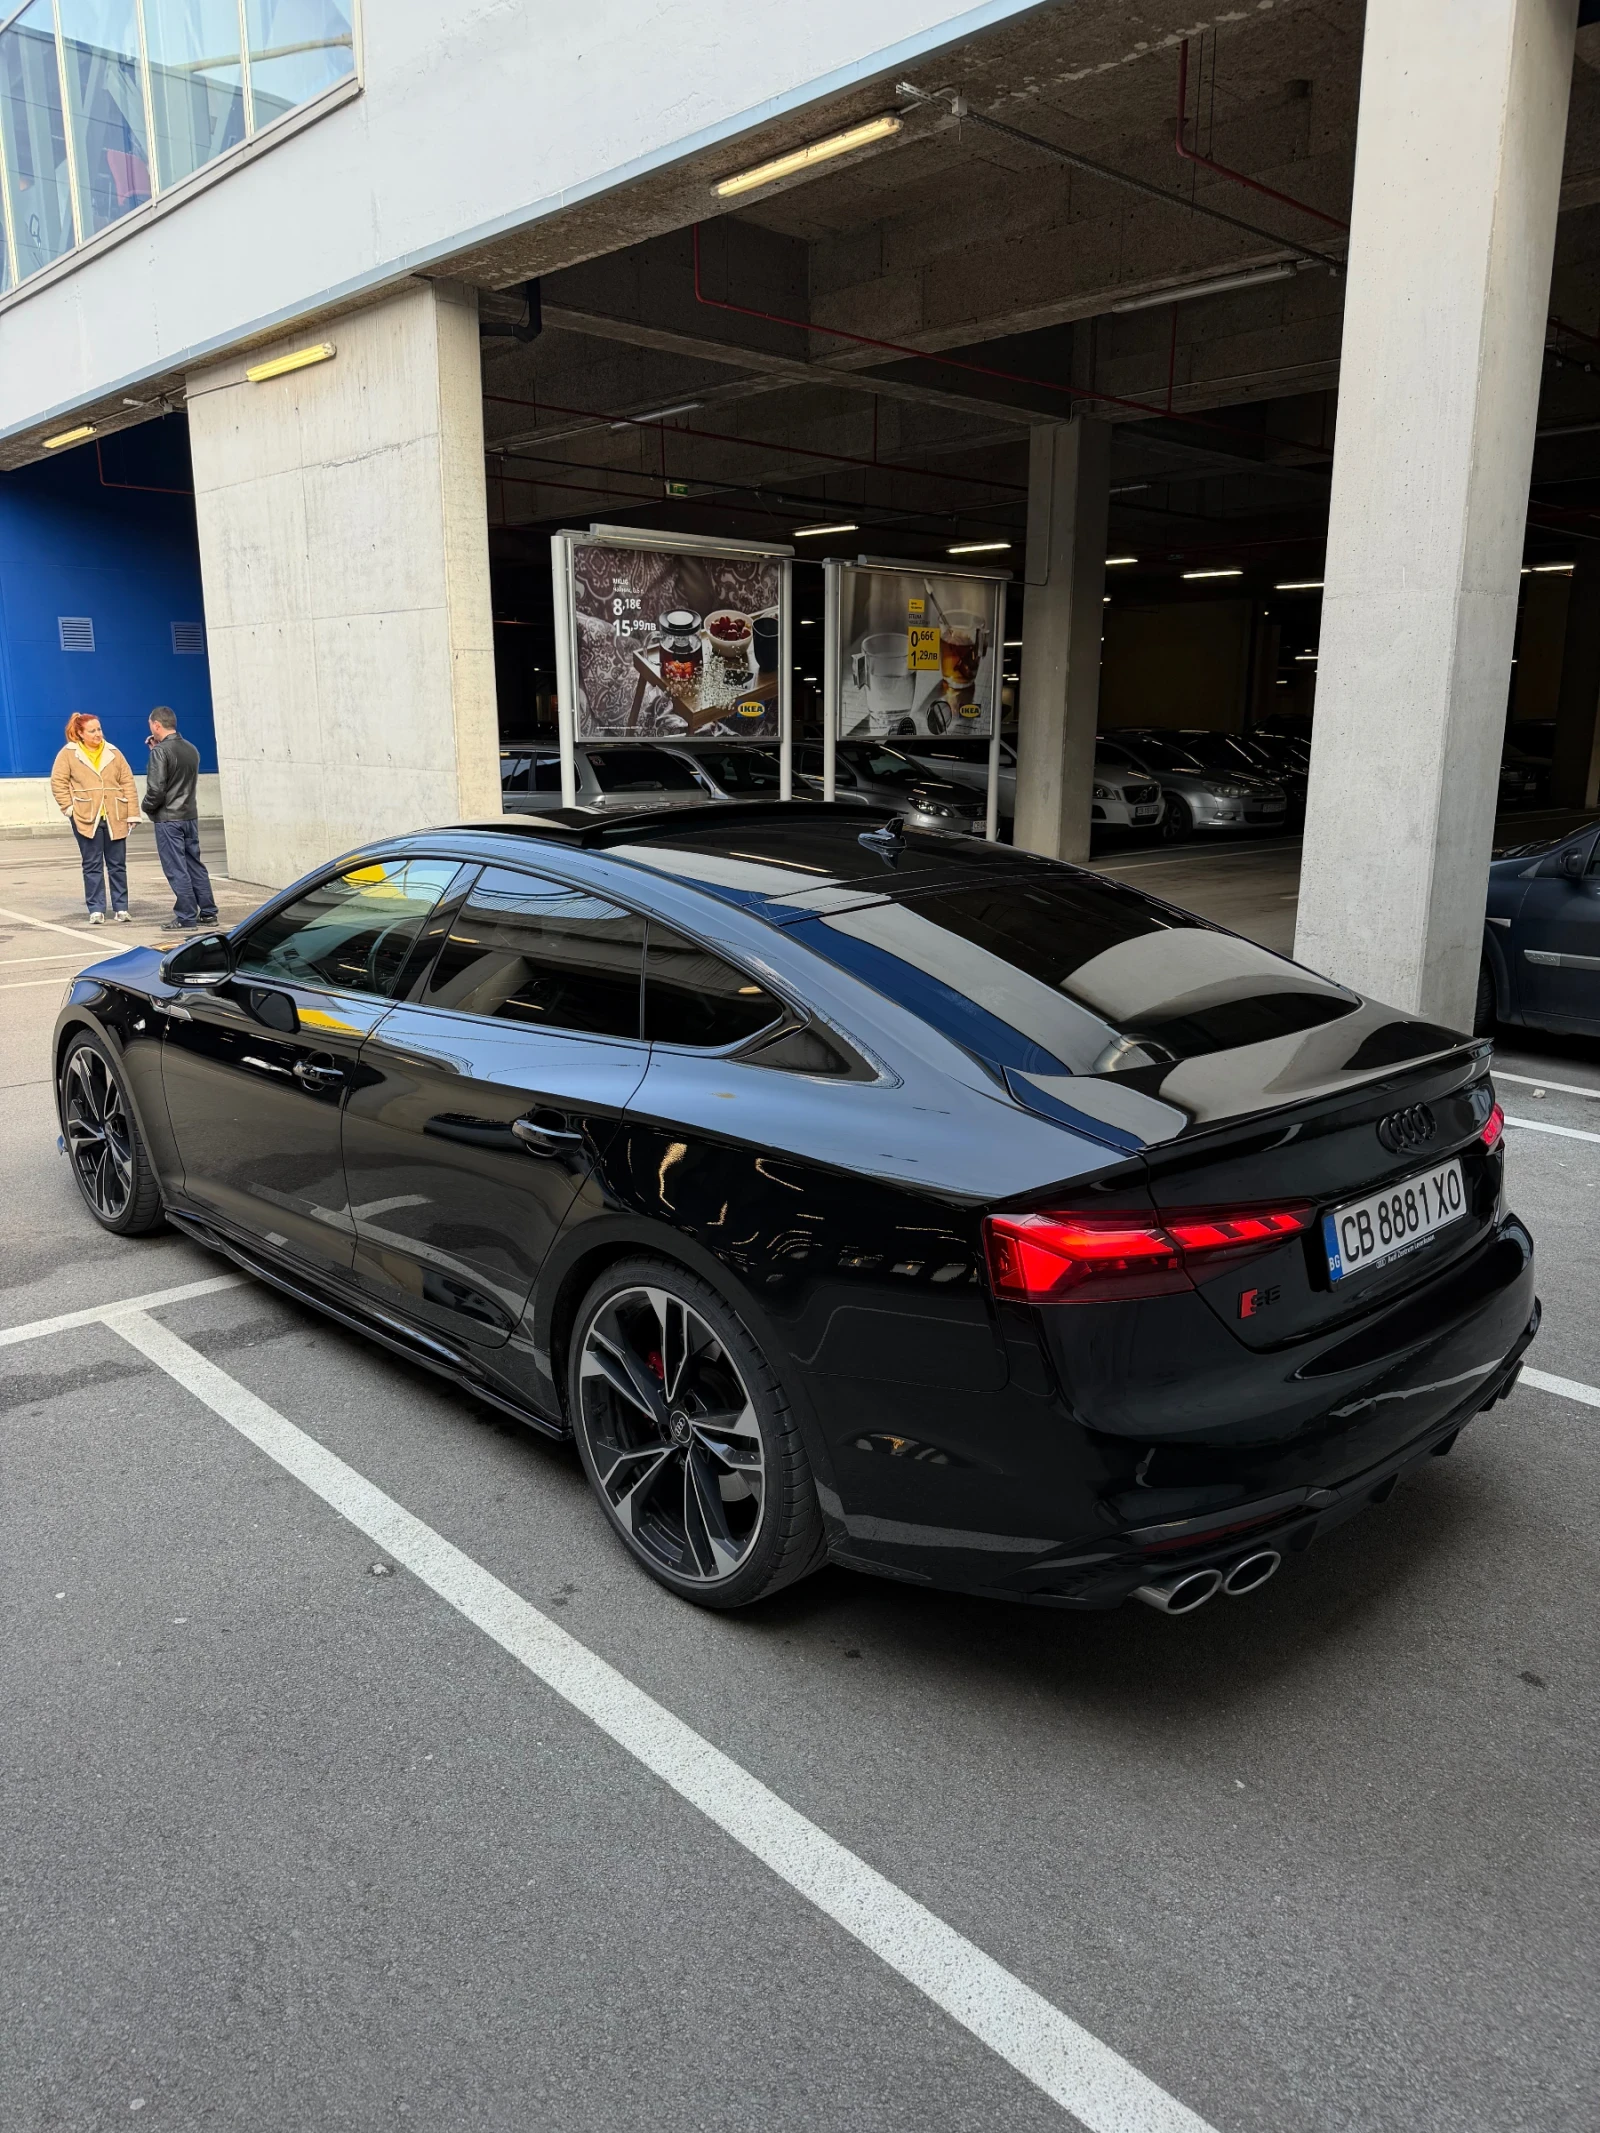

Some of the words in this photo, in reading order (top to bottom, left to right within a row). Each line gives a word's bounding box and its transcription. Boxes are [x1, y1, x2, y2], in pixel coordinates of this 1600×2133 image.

[612, 598, 642, 616] 8,18€
[612, 619, 657, 637] 15,99лв
[911, 630, 935, 647] 0,66€
[911, 650, 938, 667] 1,29лв
[739, 705, 764, 713] IKEA
[1341, 1209, 1374, 1263] CB
[1377, 1181, 1430, 1245] 8881
[1432, 1168, 1461, 1220] XO
[1328, 1254, 1341, 1272] BG
[1387, 1253, 1397, 1264] Audi
[1397, 1245, 1414, 1258] Zentrum
